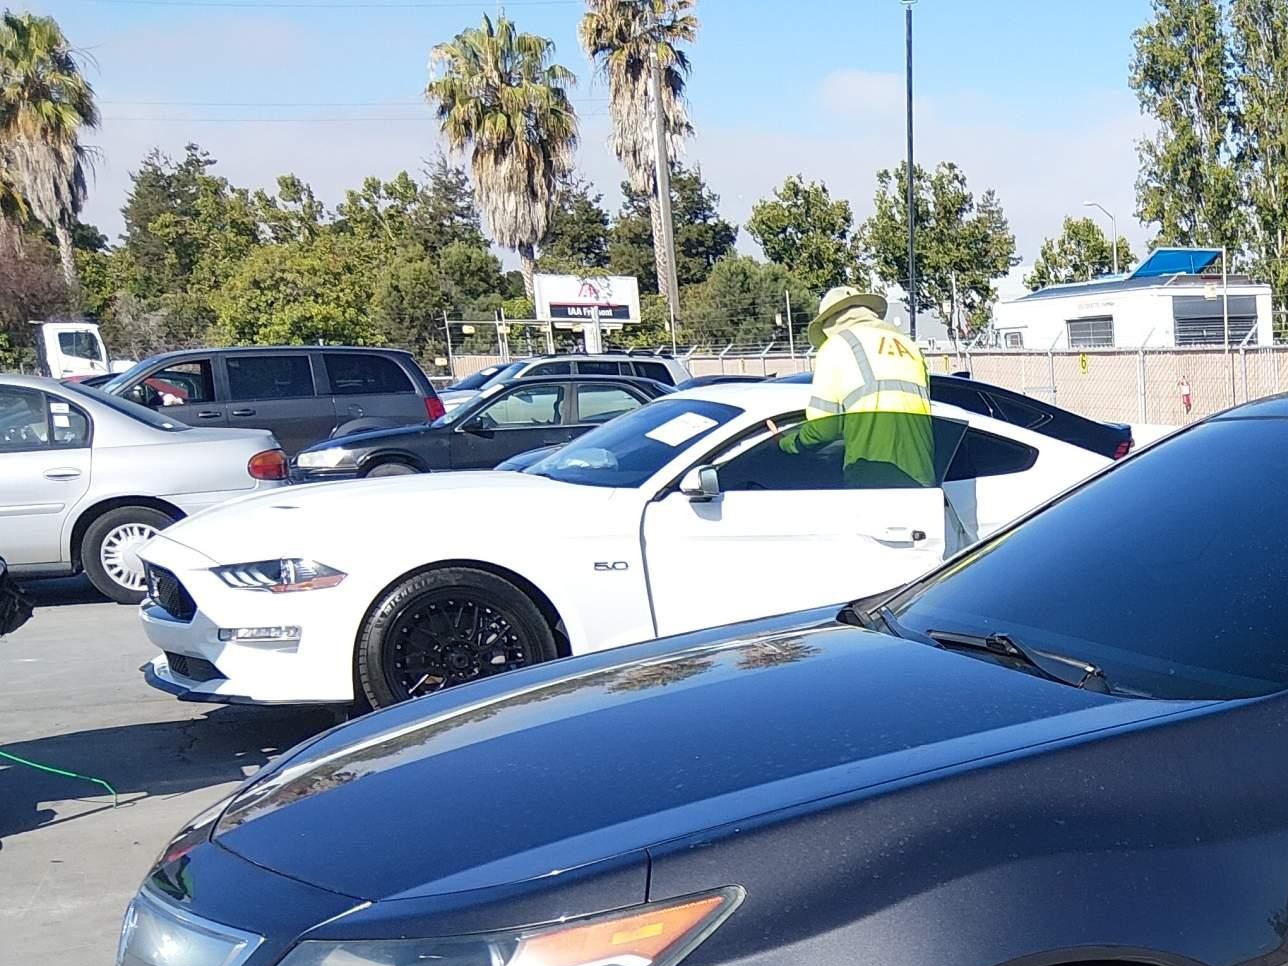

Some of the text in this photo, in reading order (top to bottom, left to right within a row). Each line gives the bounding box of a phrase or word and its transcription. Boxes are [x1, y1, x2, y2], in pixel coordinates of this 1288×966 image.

[567, 306, 614, 317] IAA Front
[878, 336, 915, 360] IA
[1080, 353, 1087, 370] 6
